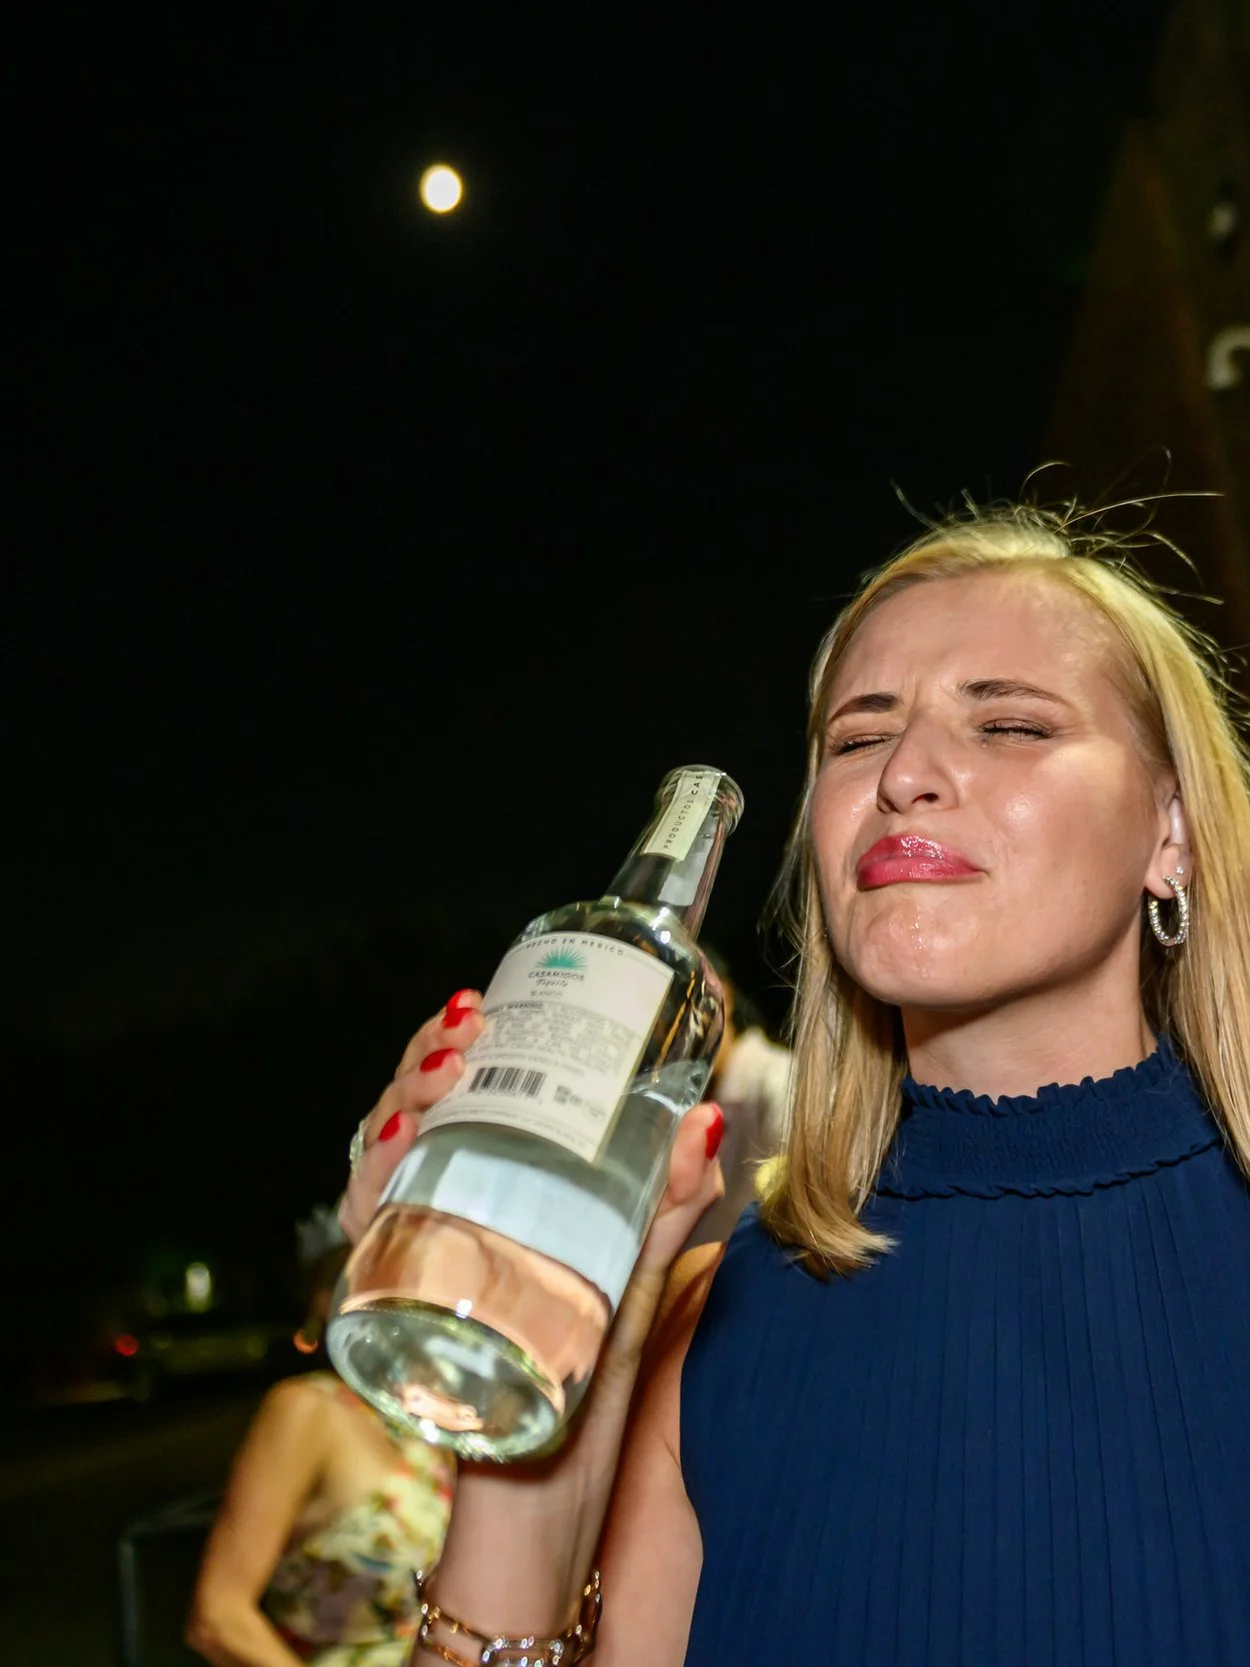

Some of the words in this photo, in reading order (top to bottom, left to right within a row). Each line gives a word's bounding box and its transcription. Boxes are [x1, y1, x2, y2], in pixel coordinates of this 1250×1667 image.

[663, 799, 695, 850] PRODUCTOS
[525, 937, 558, 949] HECHO
[562, 937, 576, 945] EN
[581, 939, 625, 957] MEXICO
[527, 970, 586, 983] CASAMIGOS
